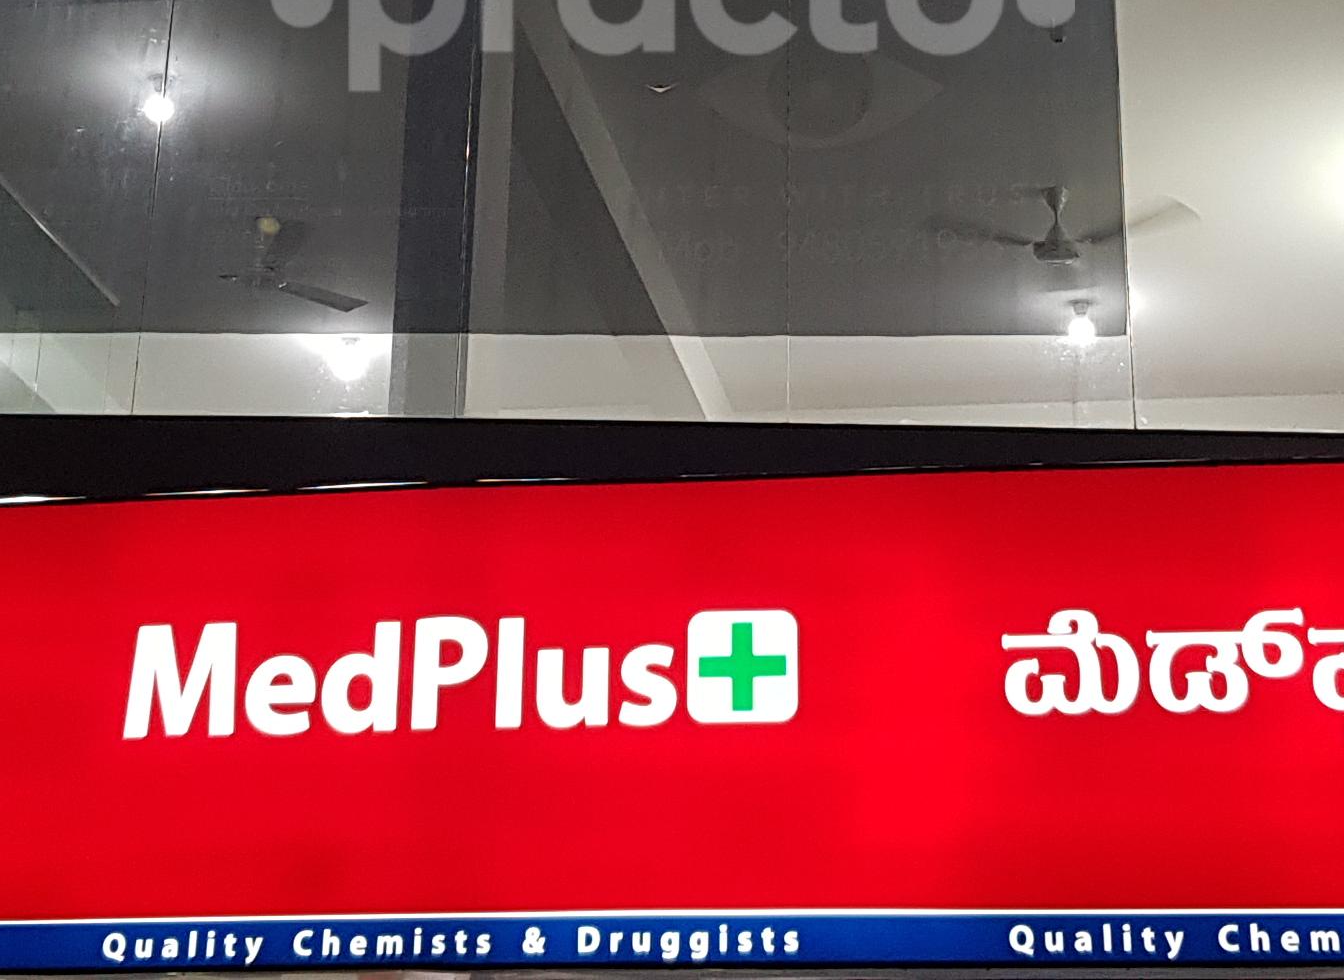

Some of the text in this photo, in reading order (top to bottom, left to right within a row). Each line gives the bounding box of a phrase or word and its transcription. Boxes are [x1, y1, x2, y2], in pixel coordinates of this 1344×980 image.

[123, 616, 678, 740] MedPlus
[102, 923, 800, 964] Quality Chemists & Druggists
[1008, 923, 1185, 959] Quality
